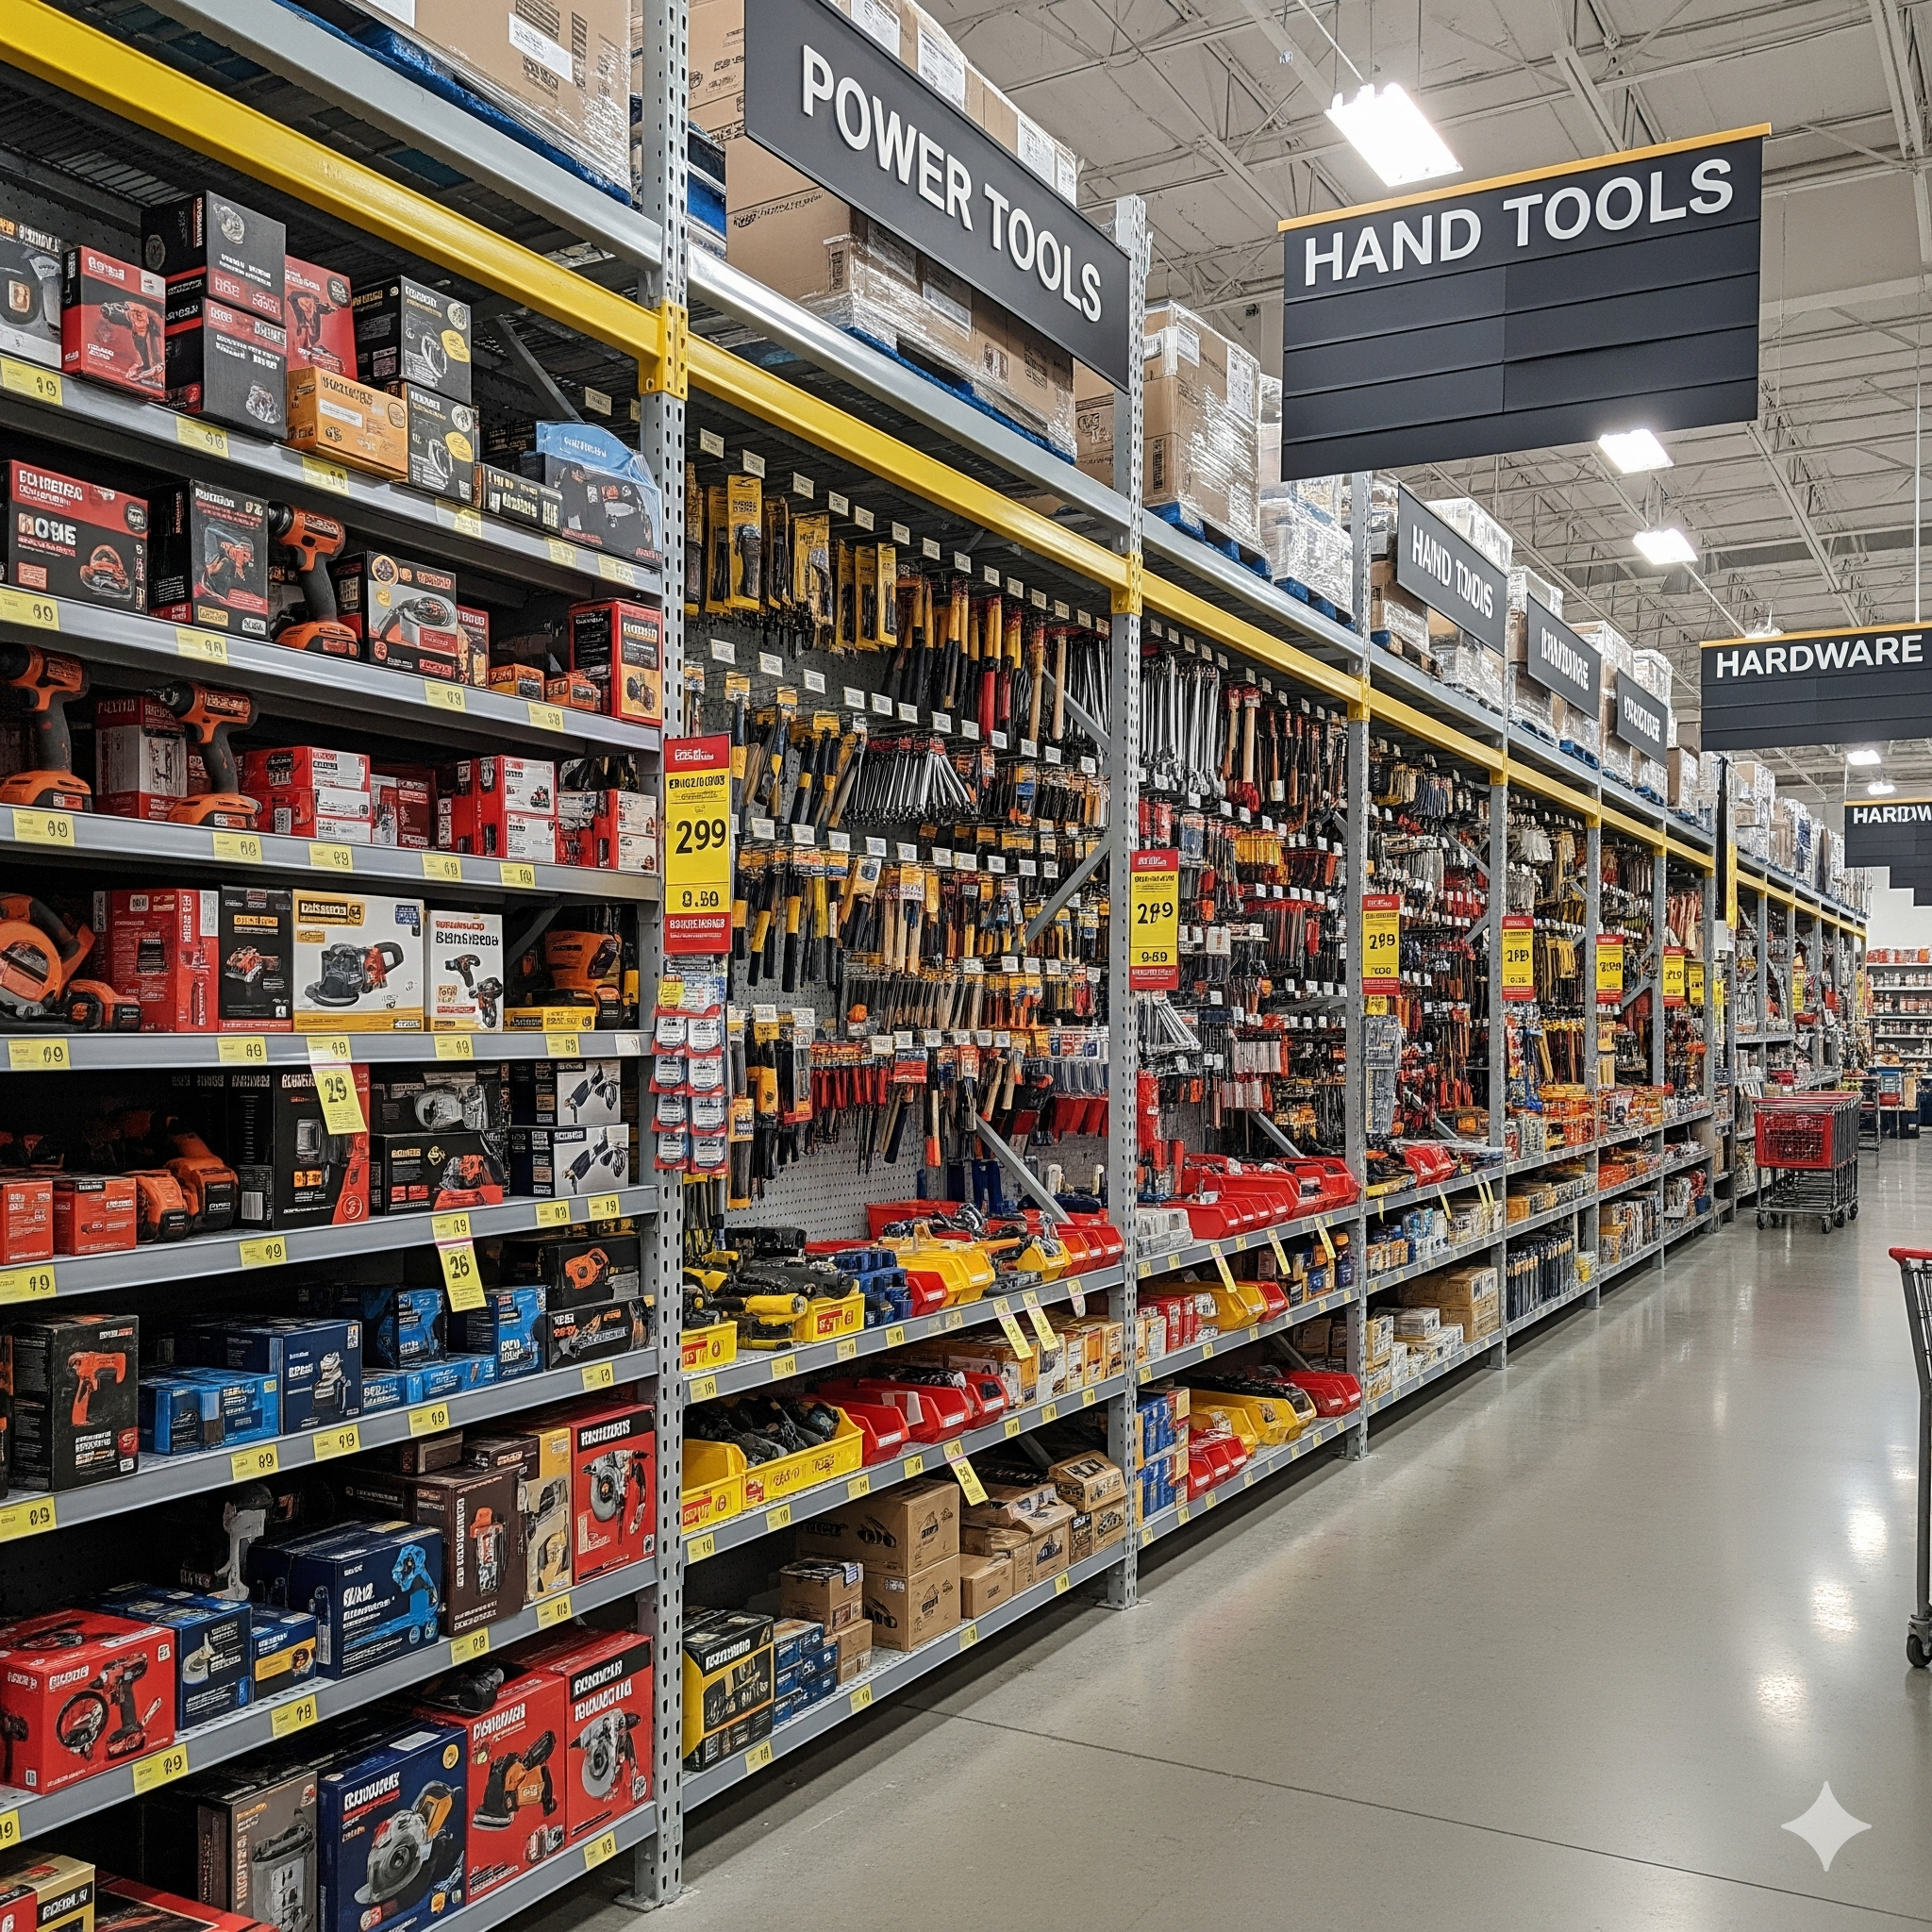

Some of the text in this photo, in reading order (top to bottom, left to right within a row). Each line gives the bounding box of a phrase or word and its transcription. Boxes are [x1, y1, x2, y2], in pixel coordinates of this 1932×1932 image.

[802, 44, 1101, 322] POWER TOOLS
[1305, 158, 1733, 286] HAND TOOLS
[1717, 634, 1924, 678] HARDWARE
[675, 818, 726, 855] 299
